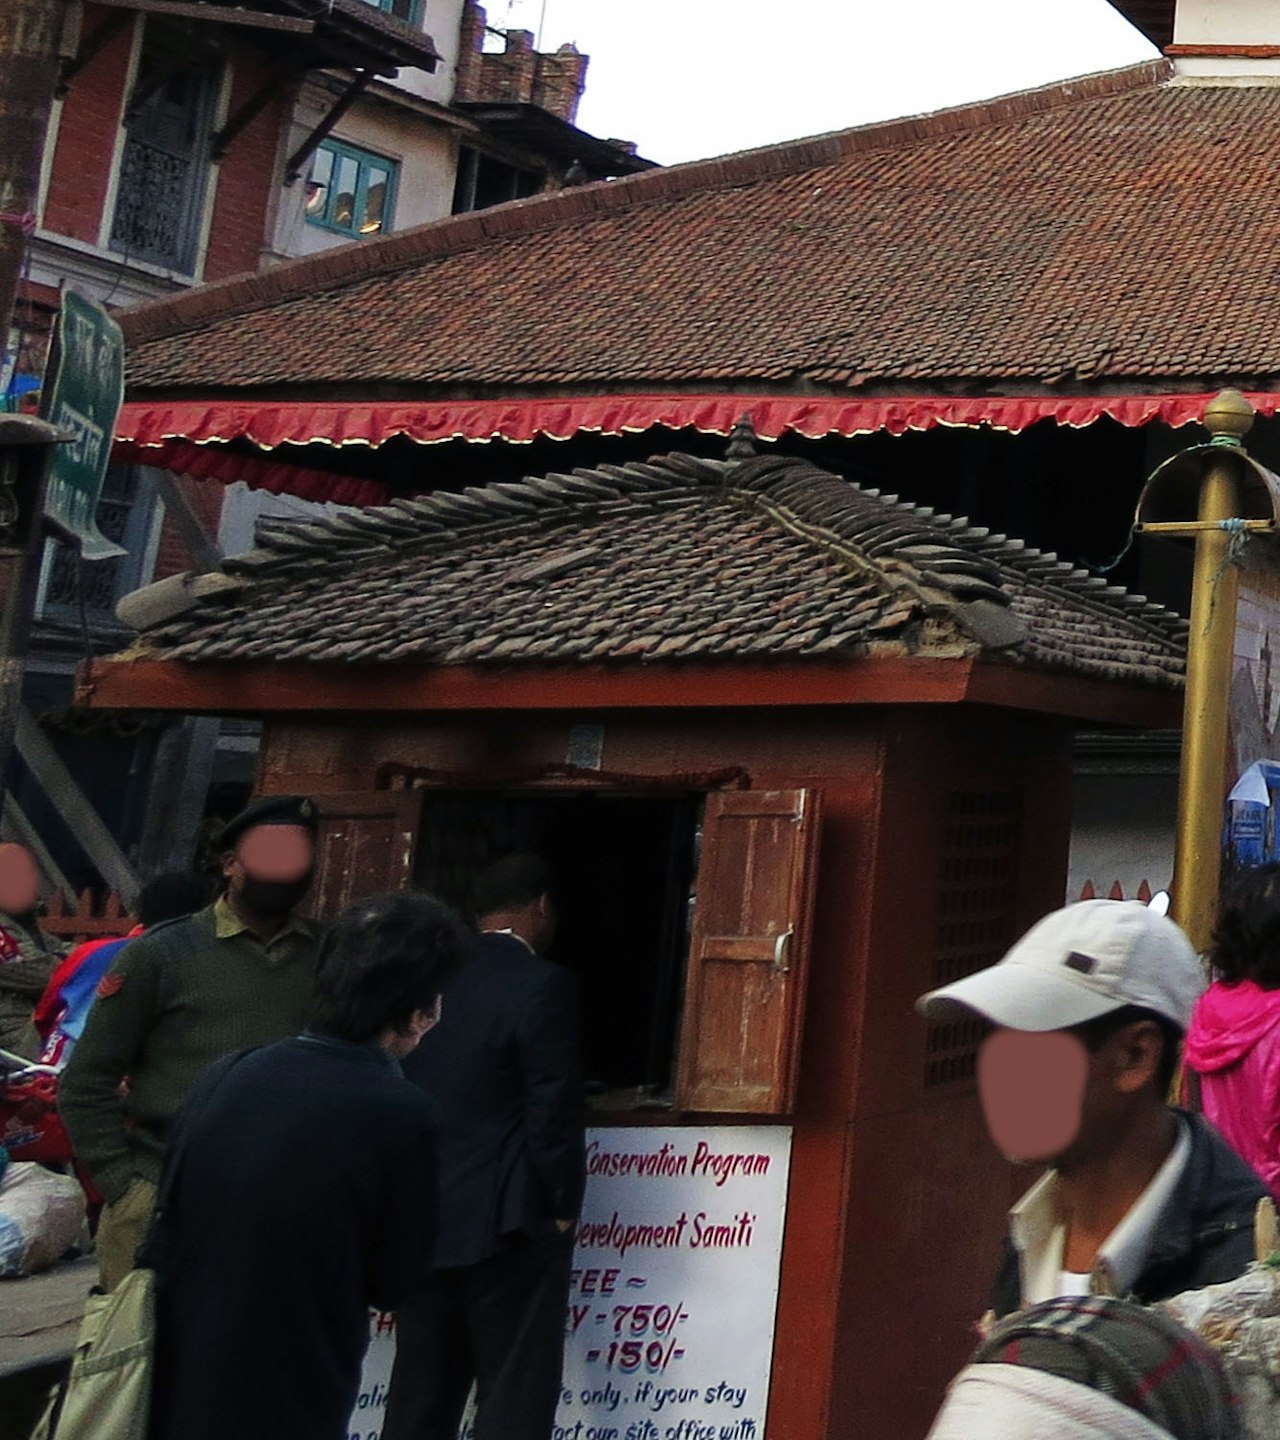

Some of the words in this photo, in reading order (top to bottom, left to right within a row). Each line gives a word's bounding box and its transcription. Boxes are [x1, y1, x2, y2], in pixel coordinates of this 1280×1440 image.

[691, 1142, 770, 1186] Program
[690, 1212, 756, 1248] Samiti
[635, 1381, 653, 1403] if
[652, 1388, 699, 1412] your
[704, 1381, 747, 1409] stay
